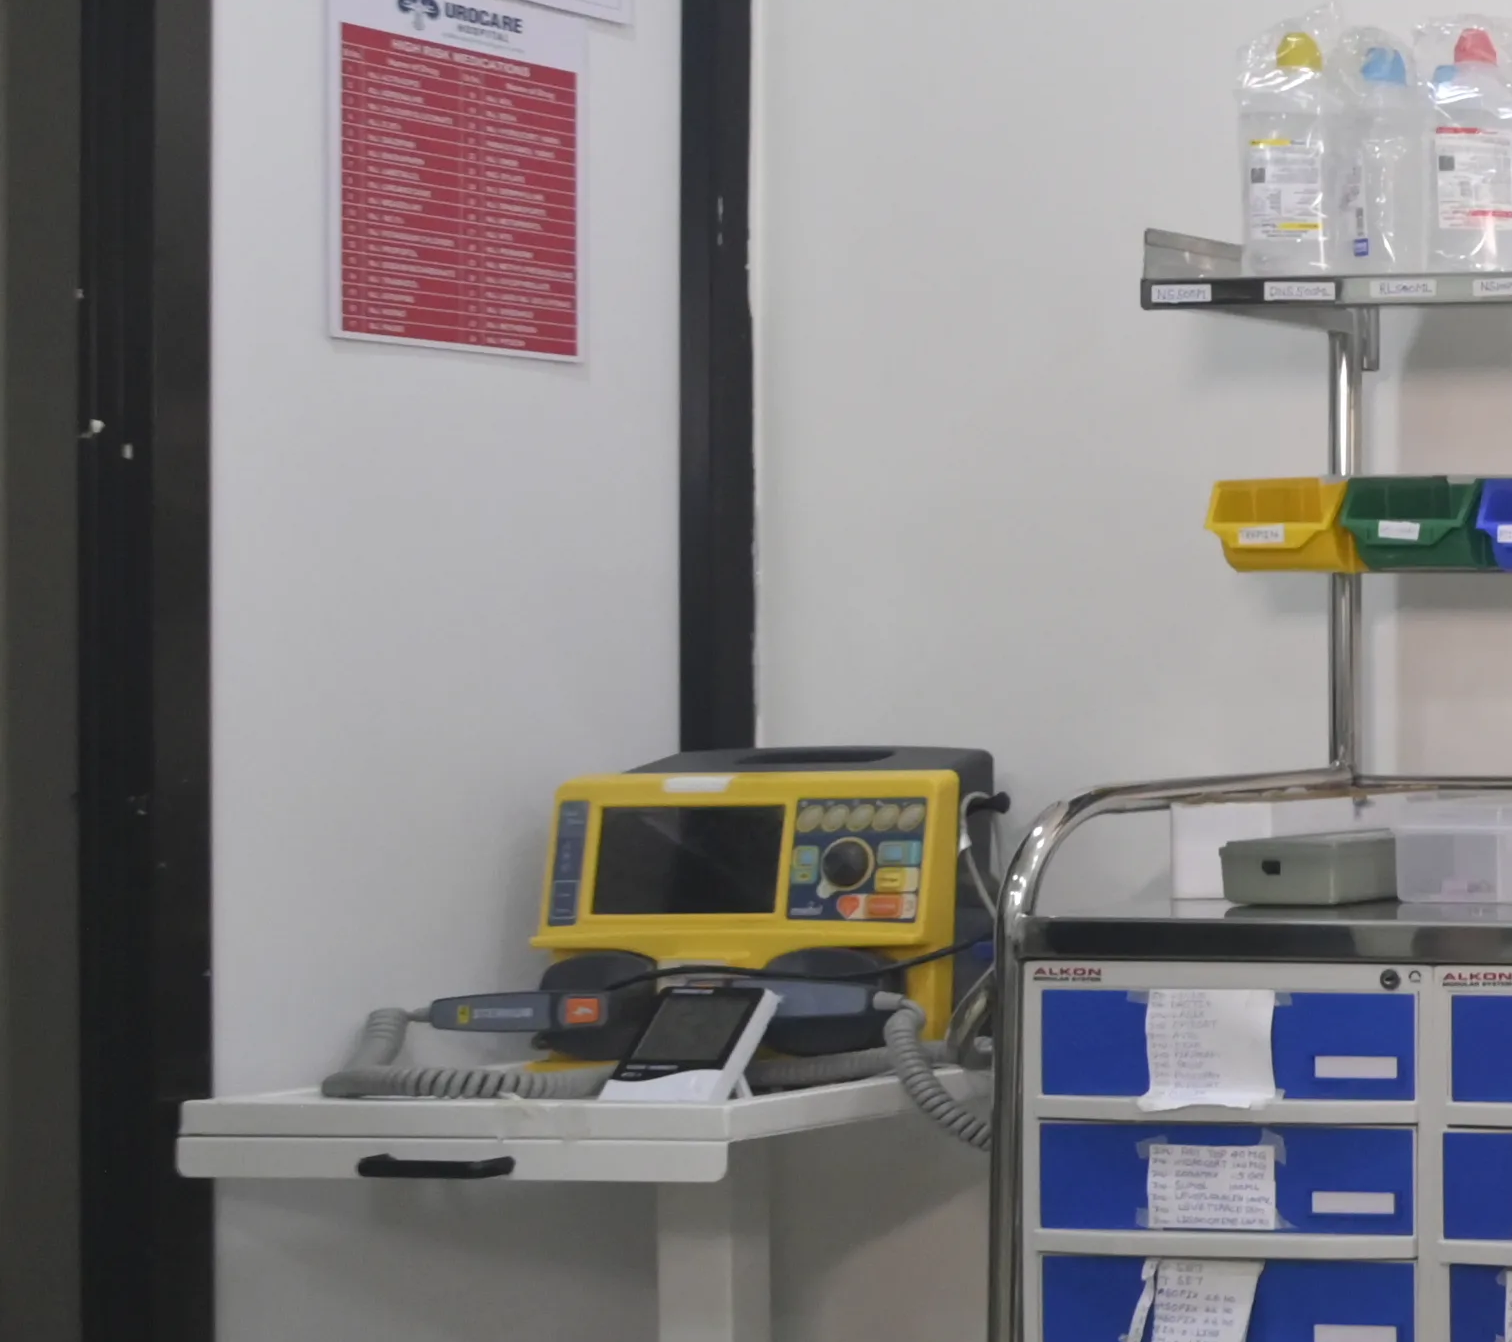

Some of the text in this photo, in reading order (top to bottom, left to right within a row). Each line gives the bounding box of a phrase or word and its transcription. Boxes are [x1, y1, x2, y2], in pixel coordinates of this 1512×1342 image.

[444, 1, 522, 35] UROCARE
[1035, 967, 1101, 975] ALKON
[1443, 972, 1512, 980] ALKON
